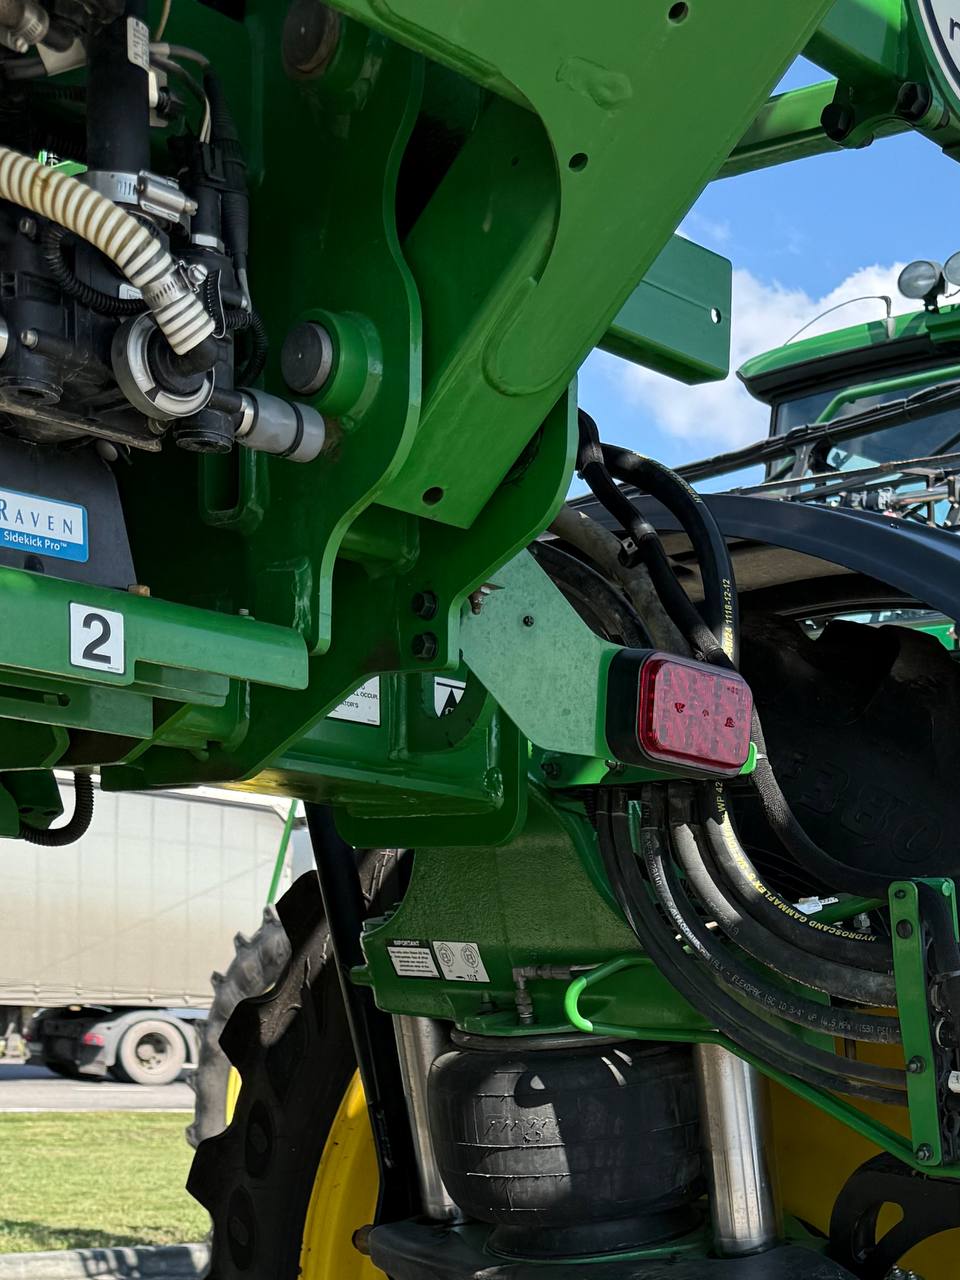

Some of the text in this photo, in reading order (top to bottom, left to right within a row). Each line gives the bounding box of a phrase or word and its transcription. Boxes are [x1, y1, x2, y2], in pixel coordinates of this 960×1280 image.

[4, 531, 42, 548] Sidekick
[82, 612, 111, 665] 2
[807, 918, 876, 941] HYDROSCAND
